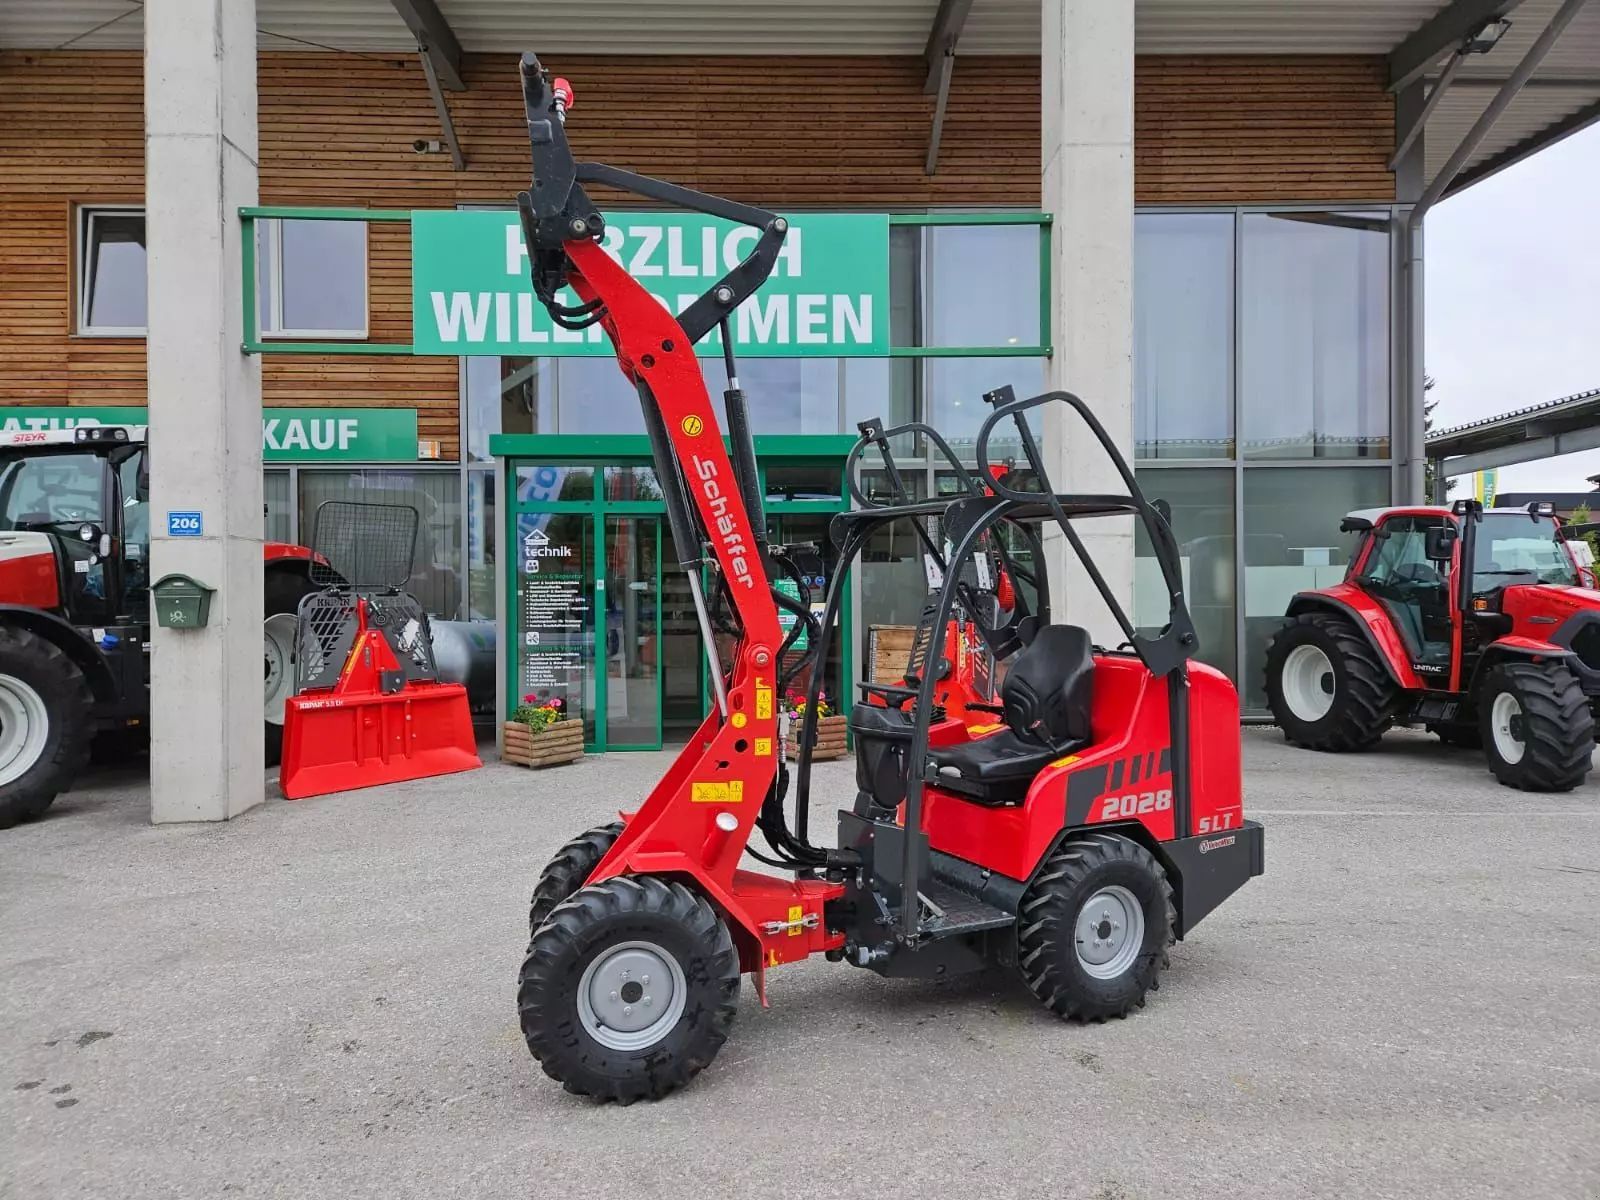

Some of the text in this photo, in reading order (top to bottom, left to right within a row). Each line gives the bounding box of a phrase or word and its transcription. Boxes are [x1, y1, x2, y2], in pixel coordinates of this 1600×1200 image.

[506, 225, 802, 277] HRZLICH
[430, 291, 873, 344] WILLMEN
[13, 432, 47, 443] STEYR
[171, 517, 199, 529] 206
[694, 455, 753, 588] Schäffer
[525, 545, 572, 557] technik
[1413, 663, 1443, 673] UNITRAC
[1101, 790, 1171, 819] 2028
[1199, 813, 1233, 833] SLT
